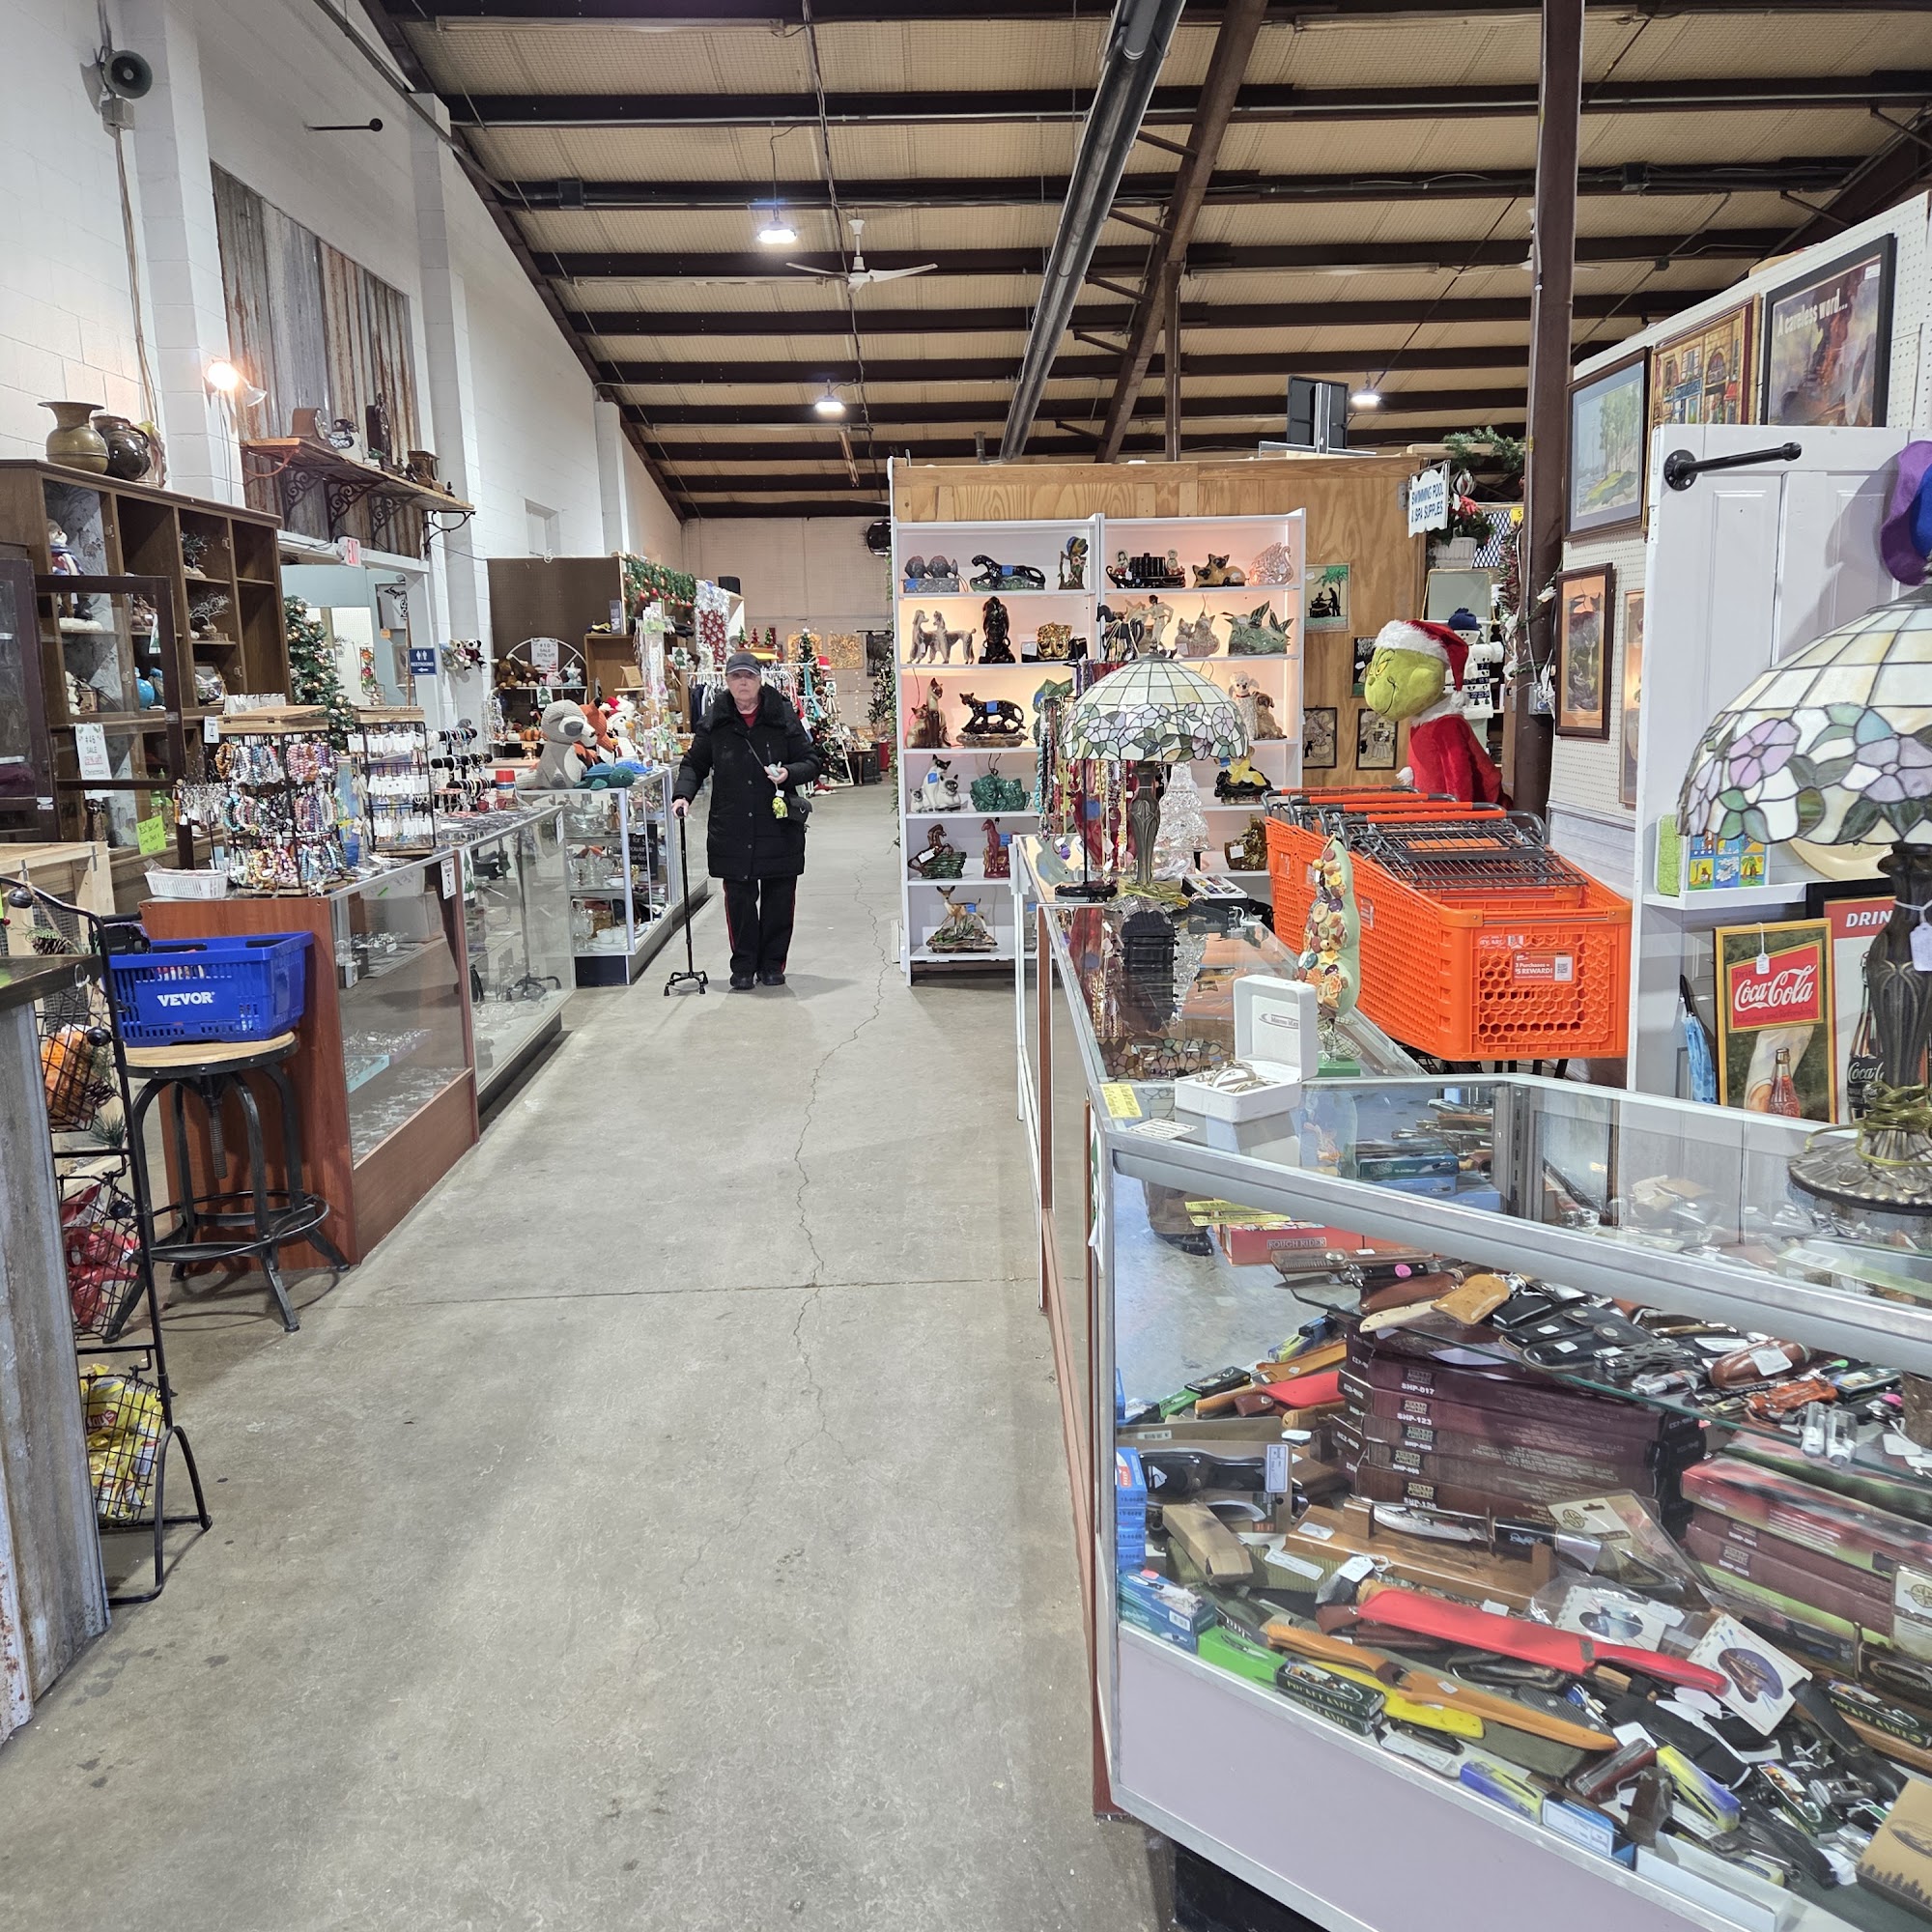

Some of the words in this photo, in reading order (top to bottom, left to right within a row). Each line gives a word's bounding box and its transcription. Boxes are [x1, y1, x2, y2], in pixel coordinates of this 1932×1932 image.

[1777, 314, 1784, 338] A
[1784, 304, 1818, 334] careless
[1411, 486, 1432, 504] SWIMMING
[1433, 483, 1444, 498] POOL
[1424, 500, 1443, 519] SUPPLIES
[347, 538, 358, 564] EXIT
[446, 873, 452, 892] 3
[1846, 910, 1893, 927] DRIN
[1734, 964, 1817, 1012] Coca-Cola
[156, 991, 214, 1007] VEVOR
[1268, 1239, 1298, 1248] ROUGH
[1300, 1238, 1326, 1247] RIDER
[1401, 1382, 1435, 1395] SHP-017
[1397, 1412, 1433, 1426] SHP-123
[1287, 1680, 1323, 1700] POCKET
[1326, 1696, 1355, 1713] KNIFE
[1830, 1697, 1872, 1722] POCKET
[1875, 1718, 1912, 1739] KNIFE
